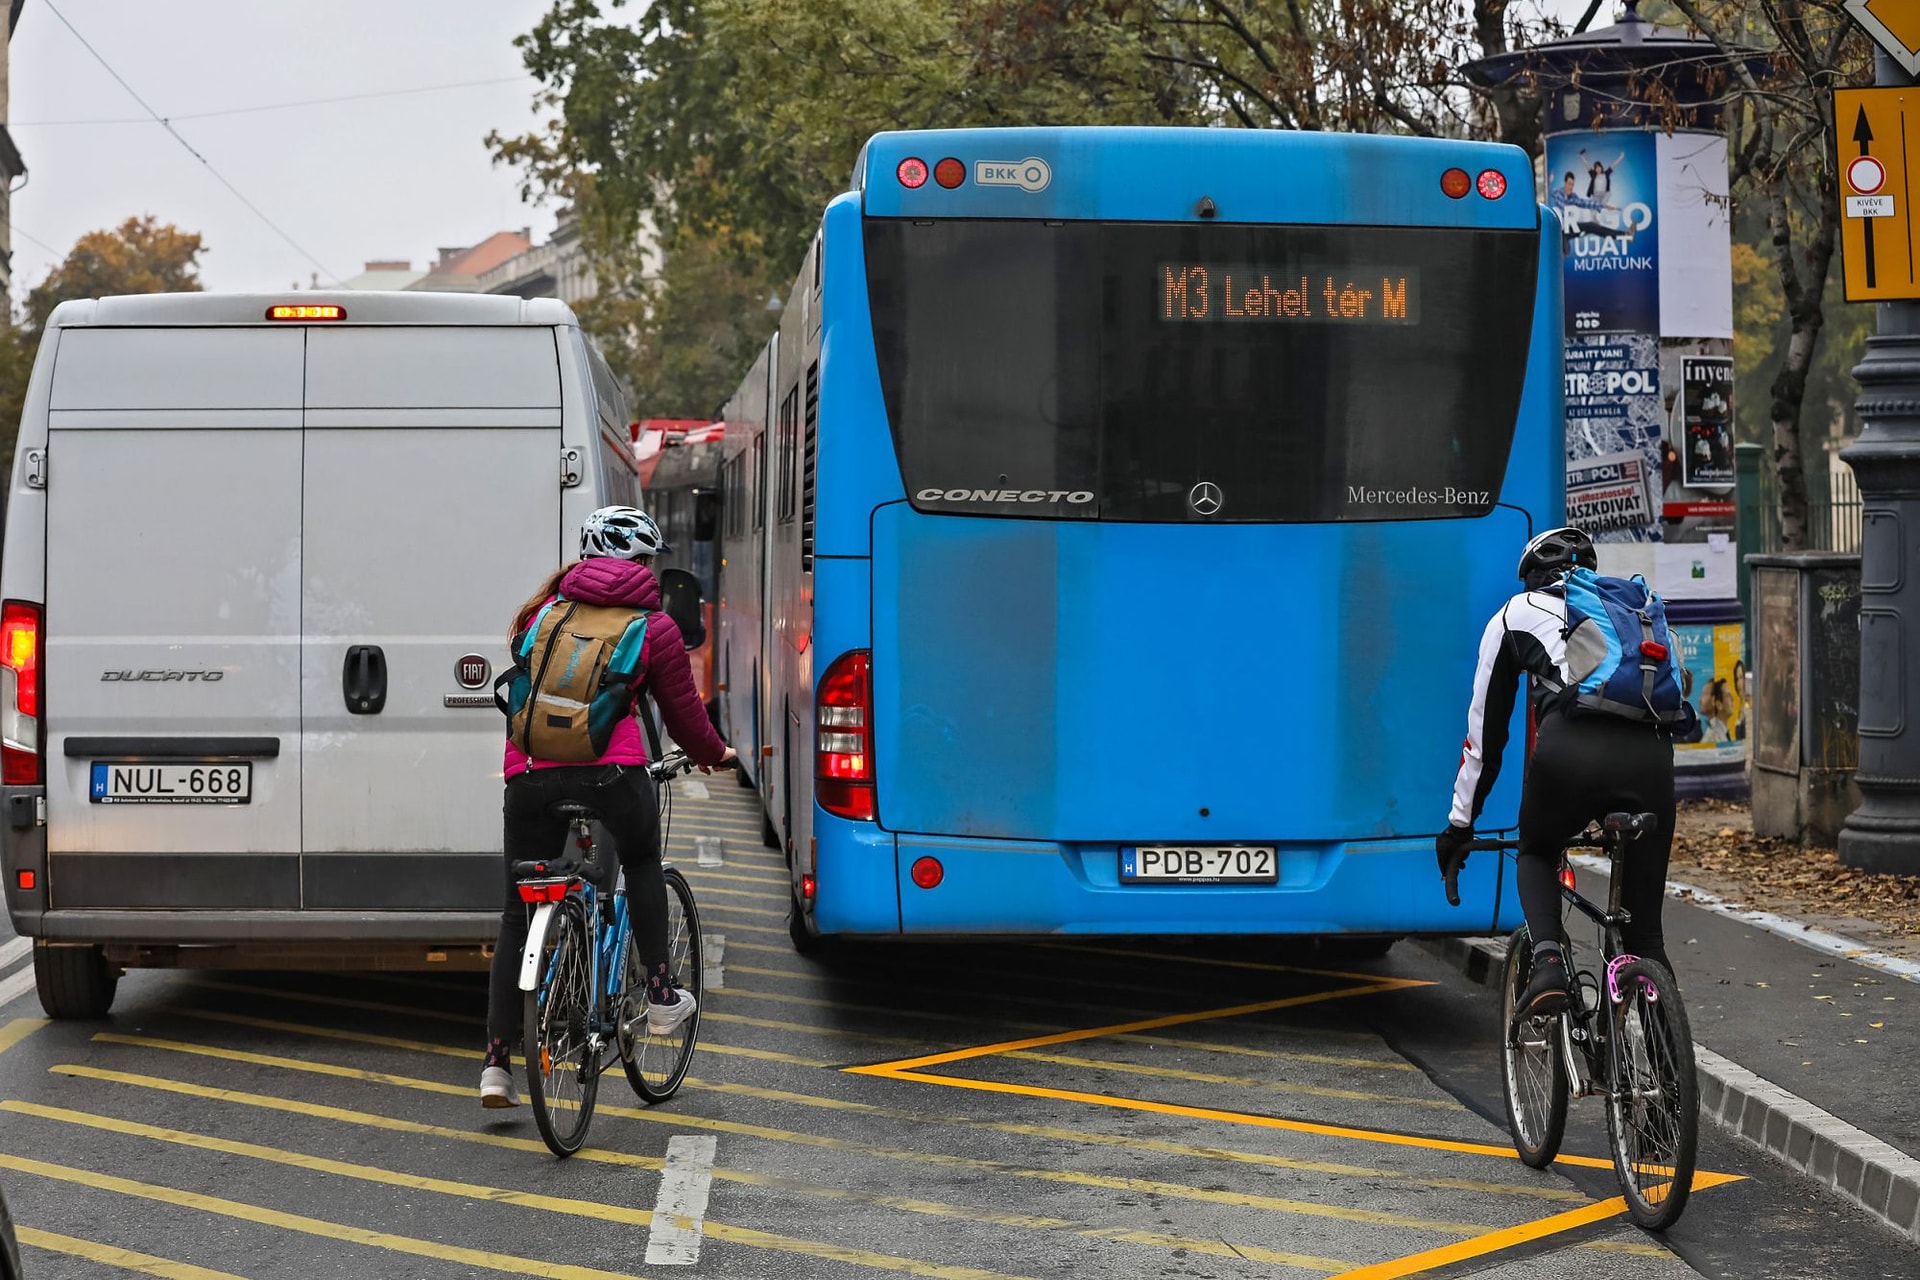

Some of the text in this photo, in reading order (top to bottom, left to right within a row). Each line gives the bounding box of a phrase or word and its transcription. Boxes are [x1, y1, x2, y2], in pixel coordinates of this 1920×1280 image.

[984, 167, 1017, 180] BKK
[1863, 208, 1879, 216] BKK
[1574, 231, 1634, 257] ÚJAT
[1574, 256, 1653, 271] MUTATUNK
[1165, 266, 1406, 318] M3 Lehel tér M
[1585, 350, 1599, 359] ITT
[1600, 349, 1623, 358] VAN!
[916, 488, 1095, 504] CONECTO
[1348, 486, 1490, 505] Mercedes-Benz
[101, 670, 224, 682] DUCATO
[463, 664, 484, 680] FIAT
[448, 696, 495, 704] PROFESSIONA
[96, 768, 242, 793] H NUL-668
[1125, 850, 1270, 875] H PDB-702
